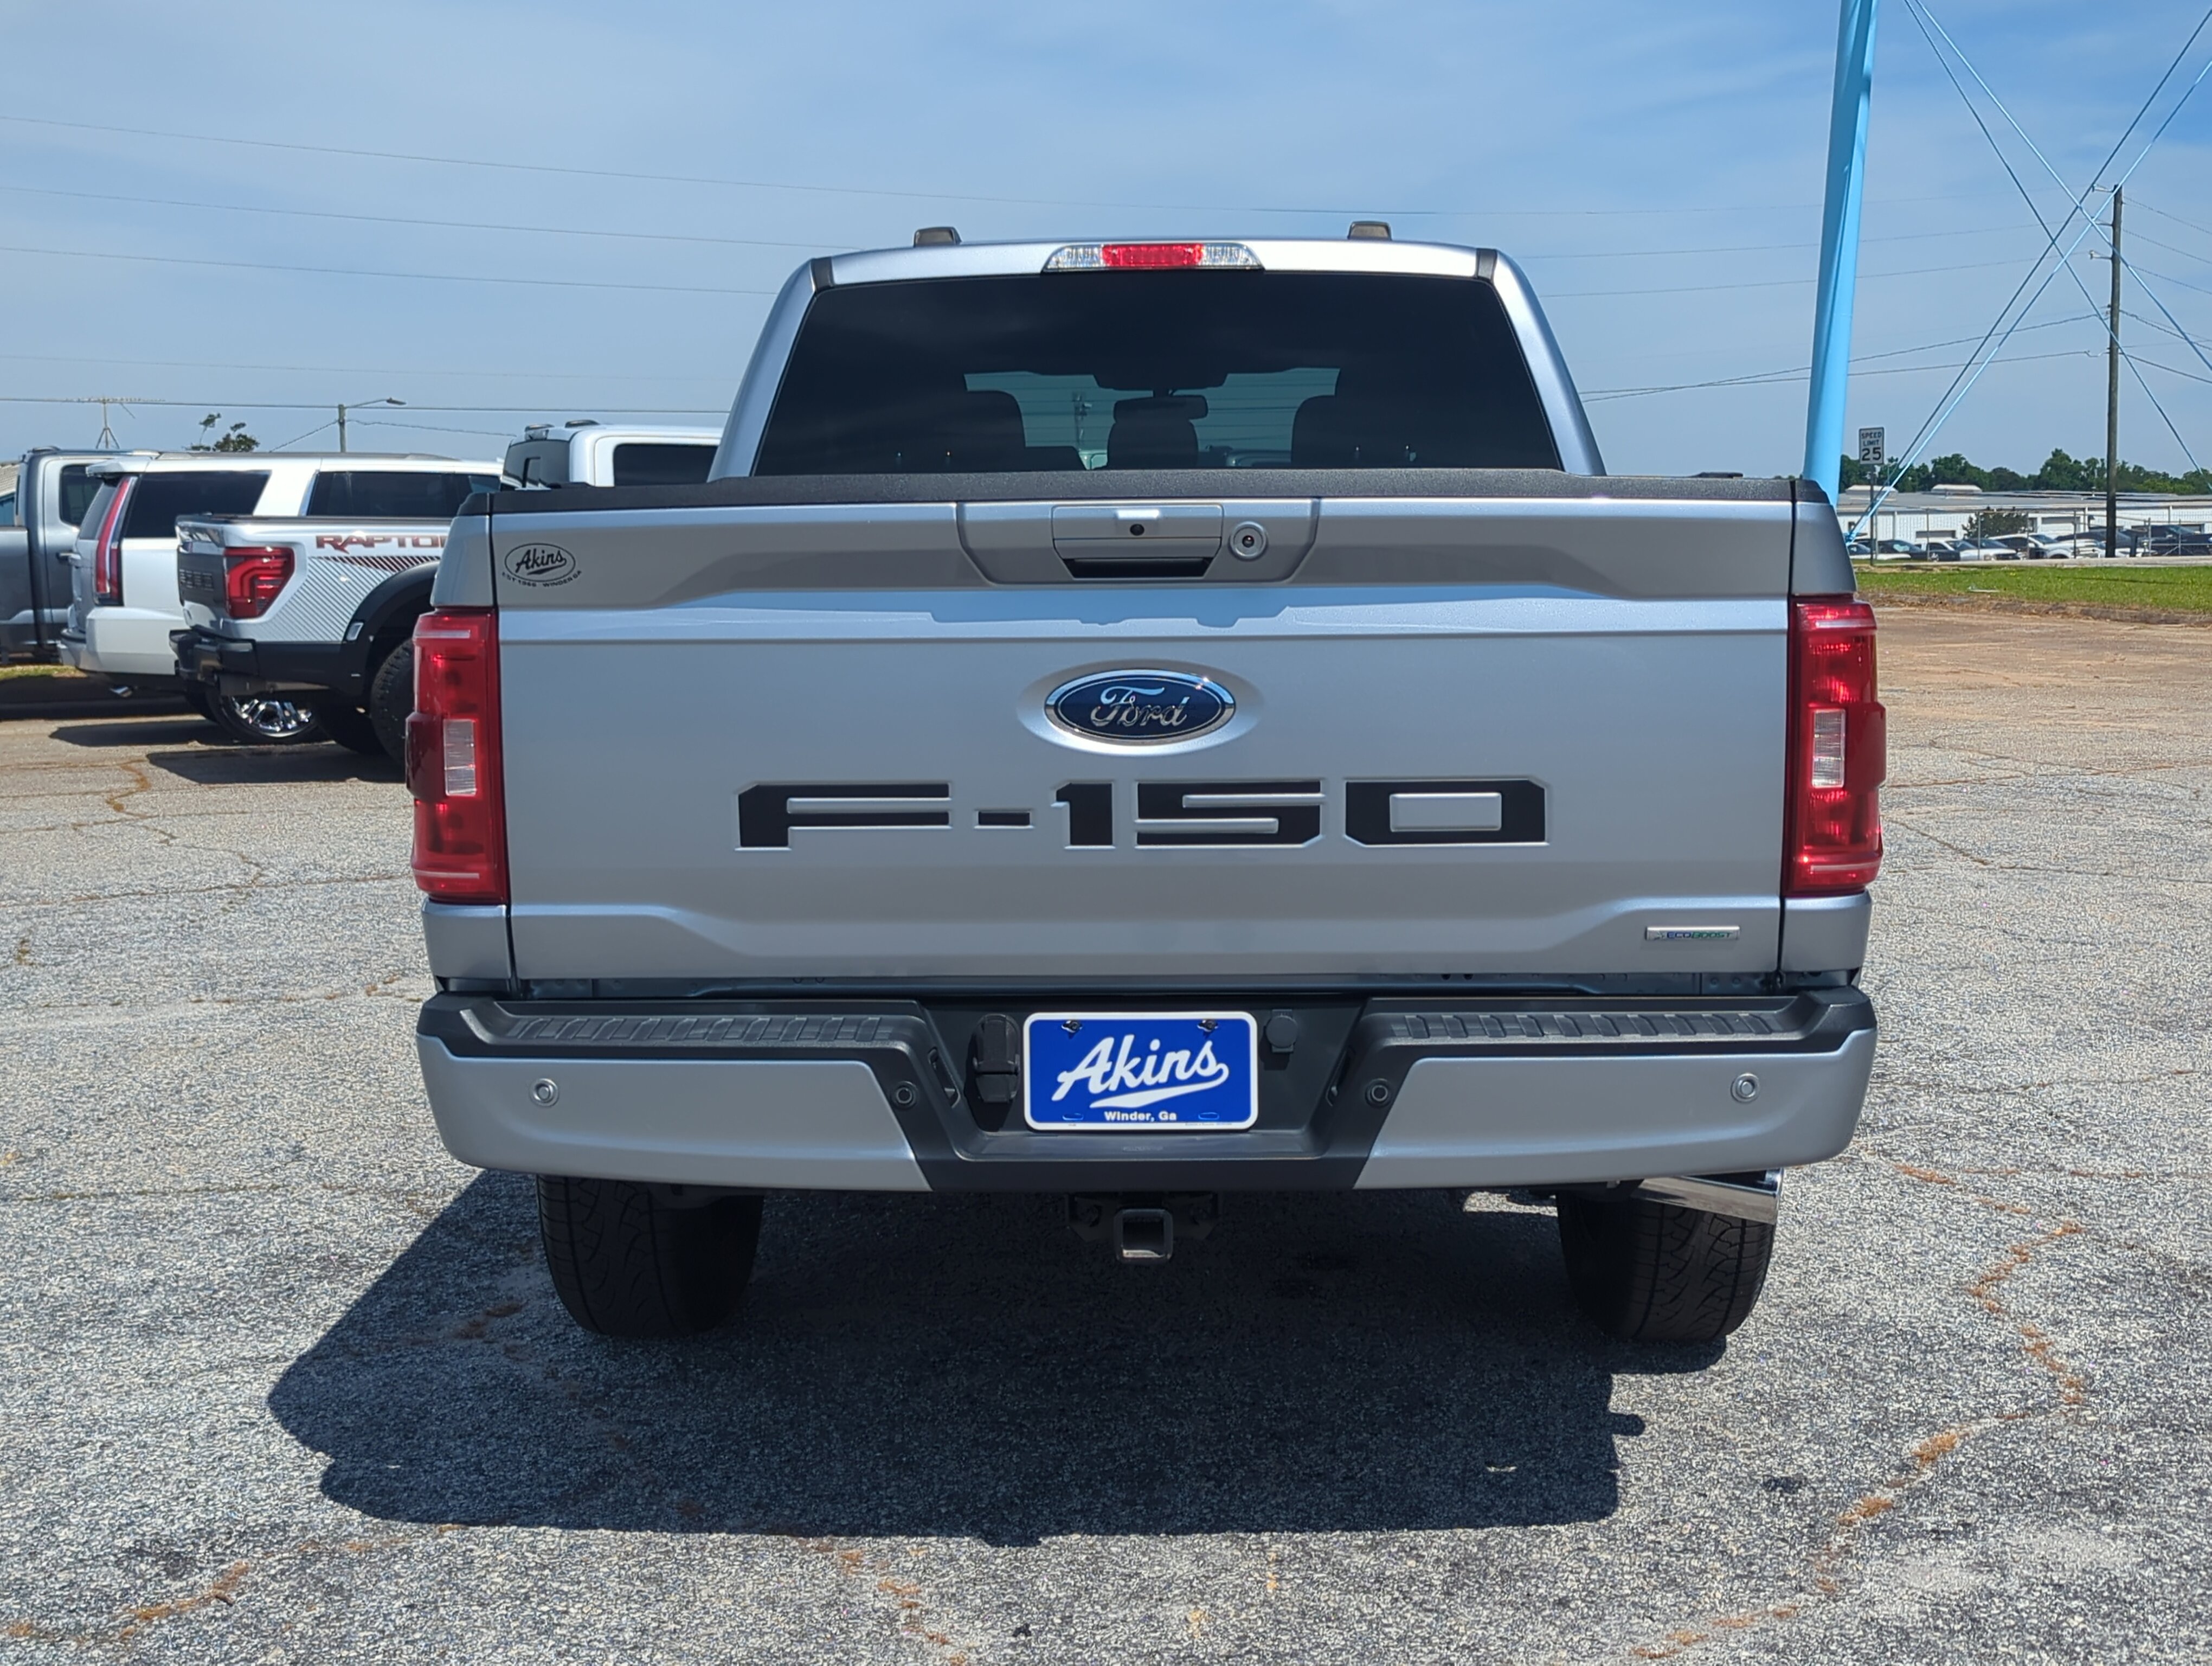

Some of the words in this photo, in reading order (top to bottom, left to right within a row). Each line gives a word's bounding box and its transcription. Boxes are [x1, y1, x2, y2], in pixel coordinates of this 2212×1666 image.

[1862, 447, 1881, 461] 25
[516, 548, 567, 575] Akins
[1090, 685, 1191, 727] Ford
[736, 779, 1548, 850] F-150
[1051, 1034, 1230, 1109] Akins
[1104, 1111, 1155, 1122] Winder,
[1158, 1111, 1177, 1121] Ga
